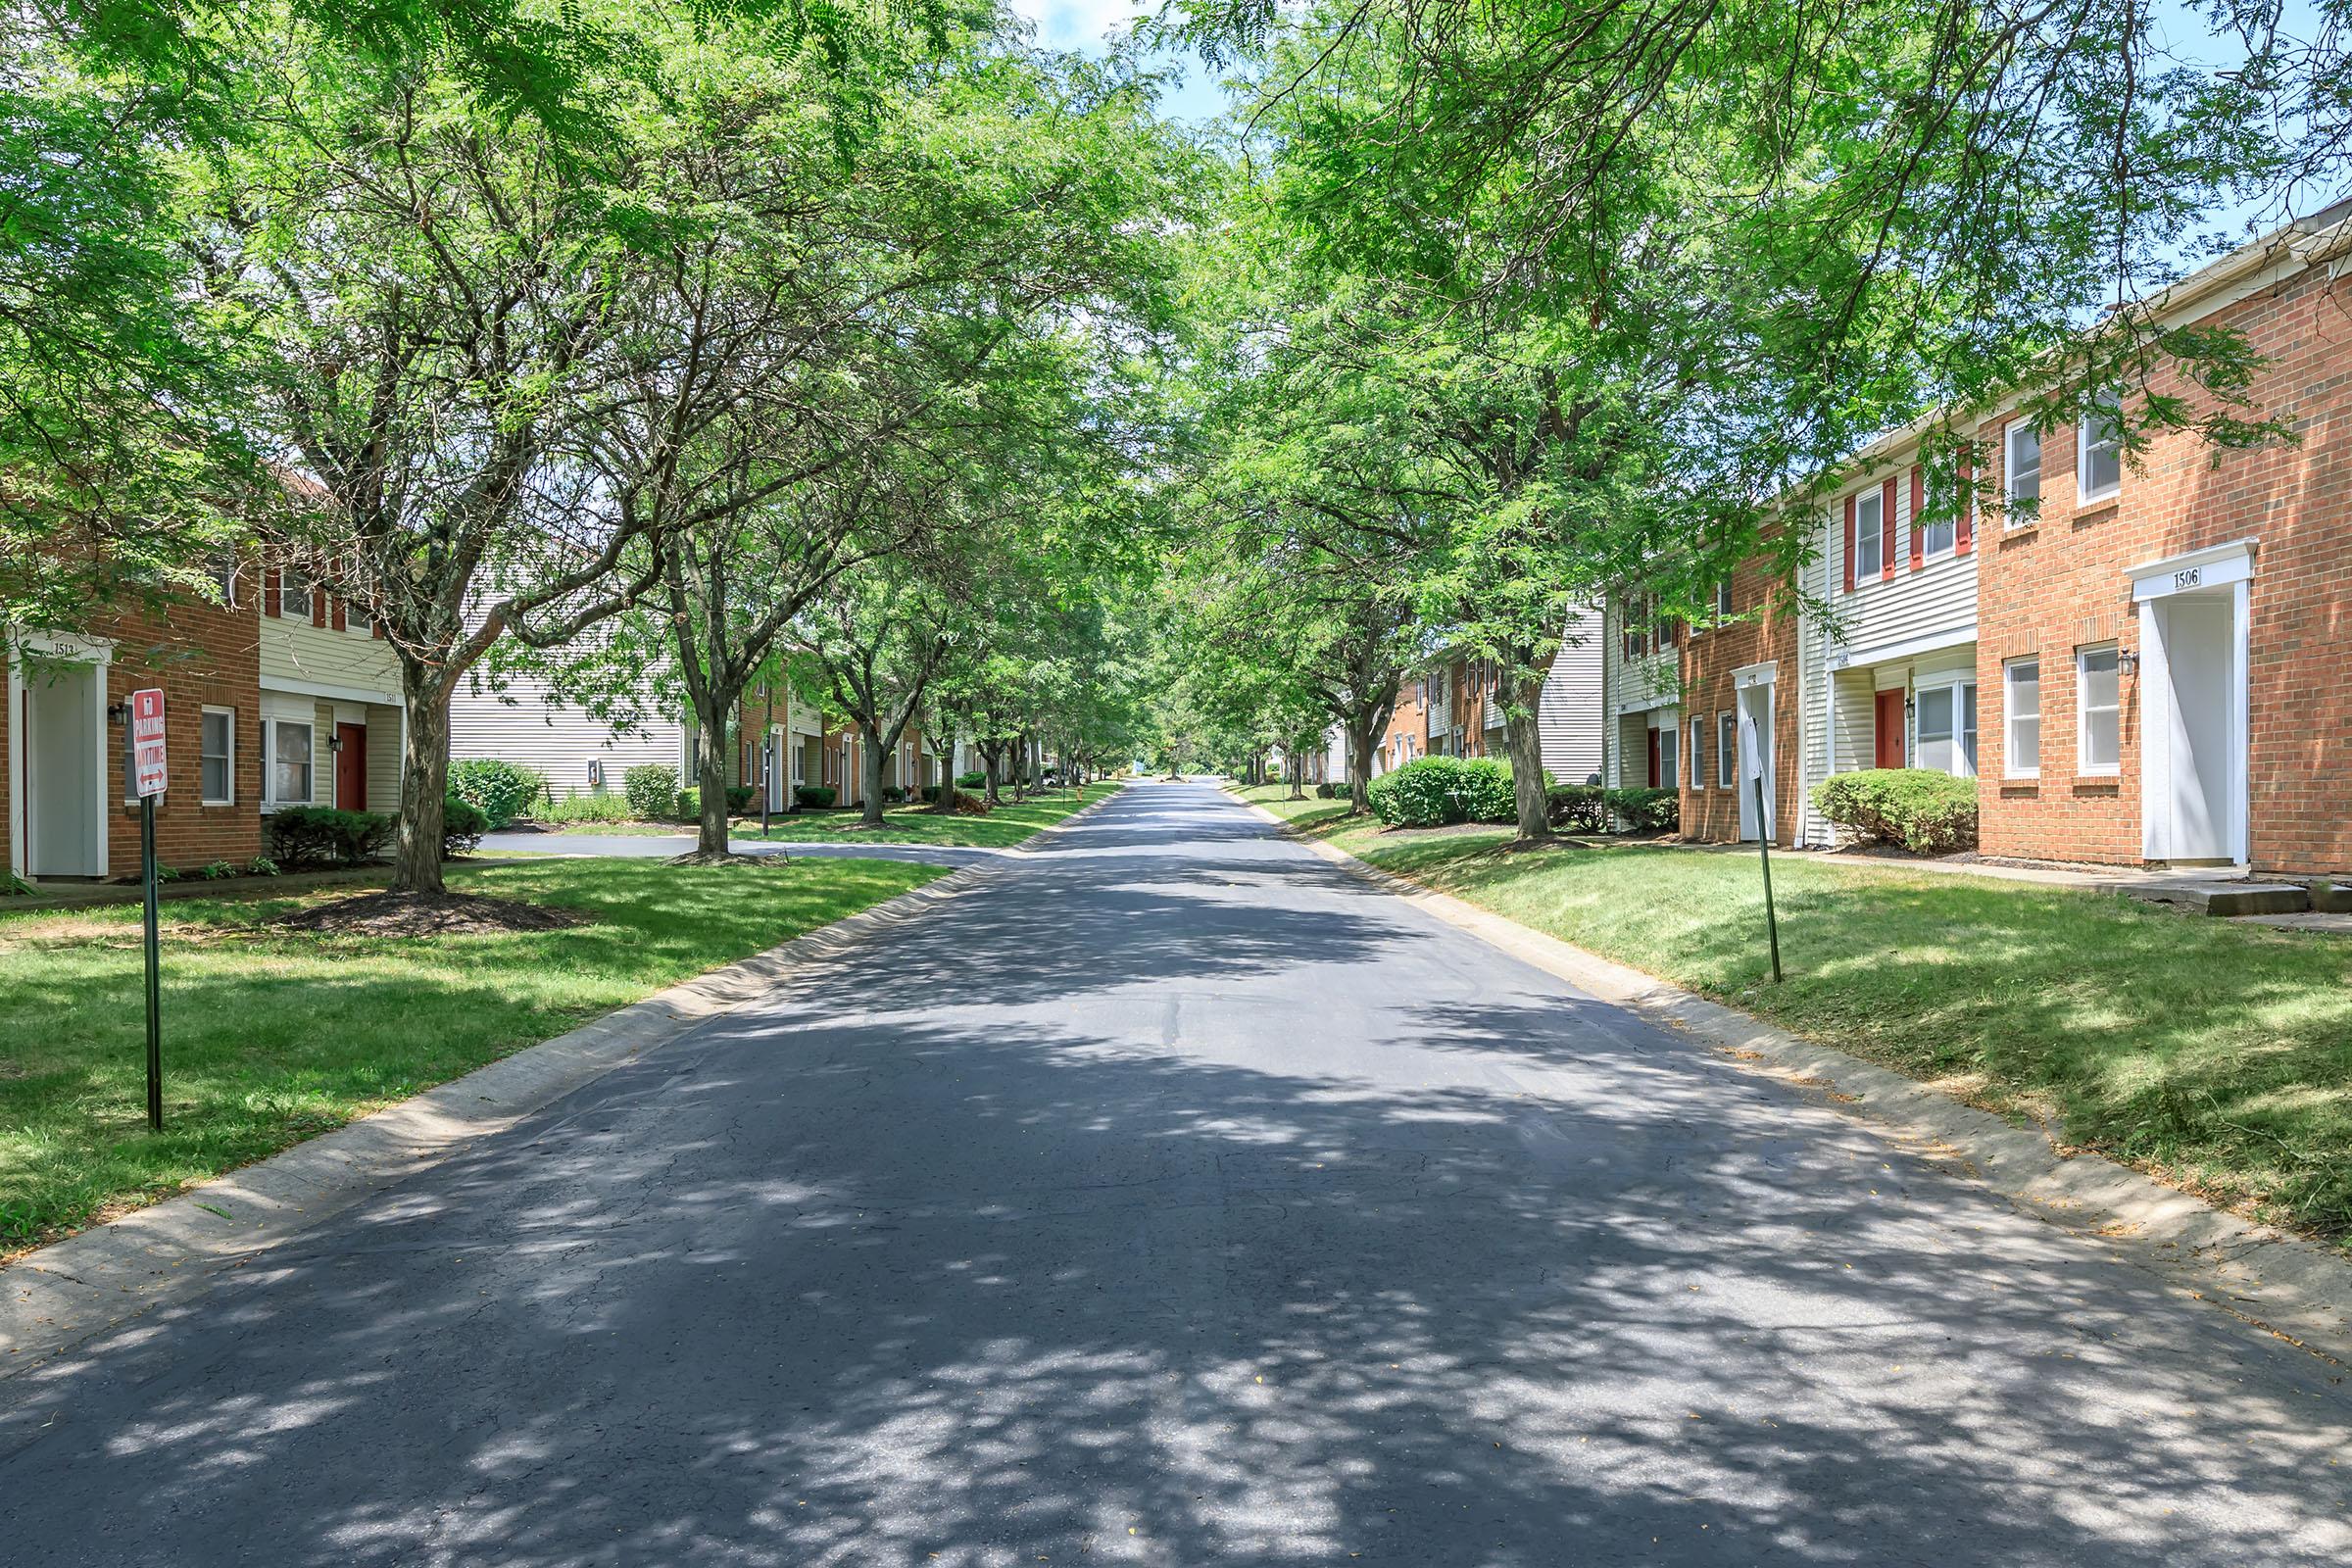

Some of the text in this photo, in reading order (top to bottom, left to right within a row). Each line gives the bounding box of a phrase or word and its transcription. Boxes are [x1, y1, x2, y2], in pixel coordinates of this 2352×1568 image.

[2174, 568, 2198, 588] 1506
[54, 643, 74, 655] 1513
[143, 697, 153, 715] NO
[135, 716, 164, 738] PARKING
[137, 746, 164, 767] ANYTIME
